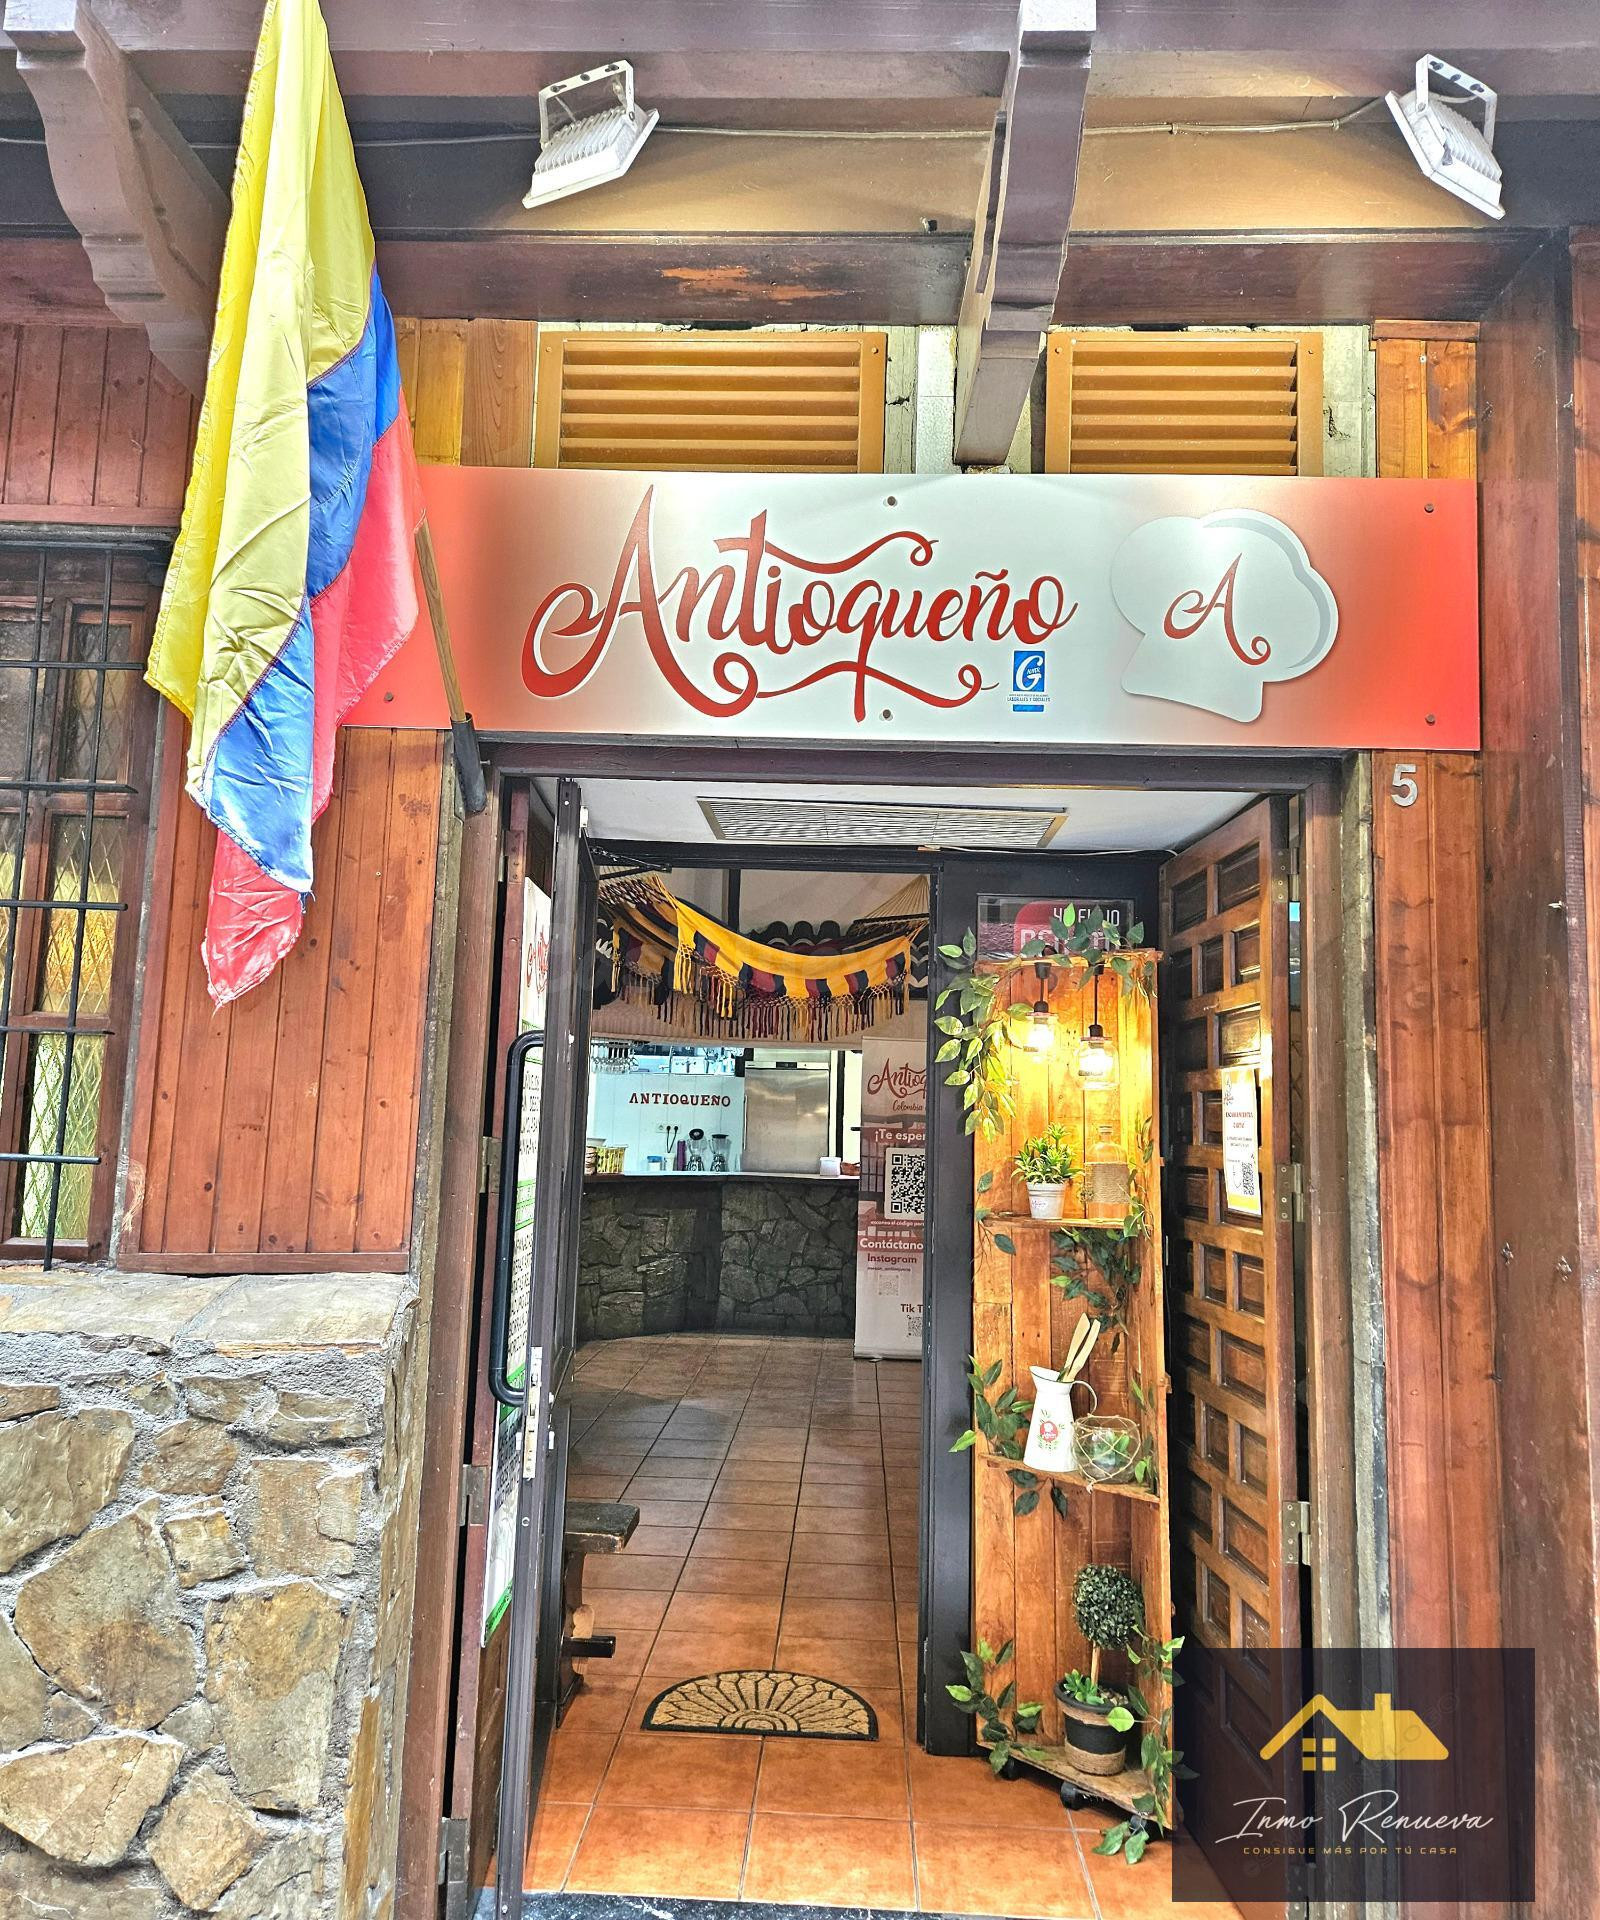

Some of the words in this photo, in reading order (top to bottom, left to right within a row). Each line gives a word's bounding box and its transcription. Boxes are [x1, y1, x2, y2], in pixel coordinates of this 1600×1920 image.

[521, 484, 1078, 722] Antioqueño
[1163, 552, 1272, 666] A
[1390, 763, 1419, 808] 5
[867, 1253, 917, 1265] Instagram
[900, 1303, 915, 1313] Tik
